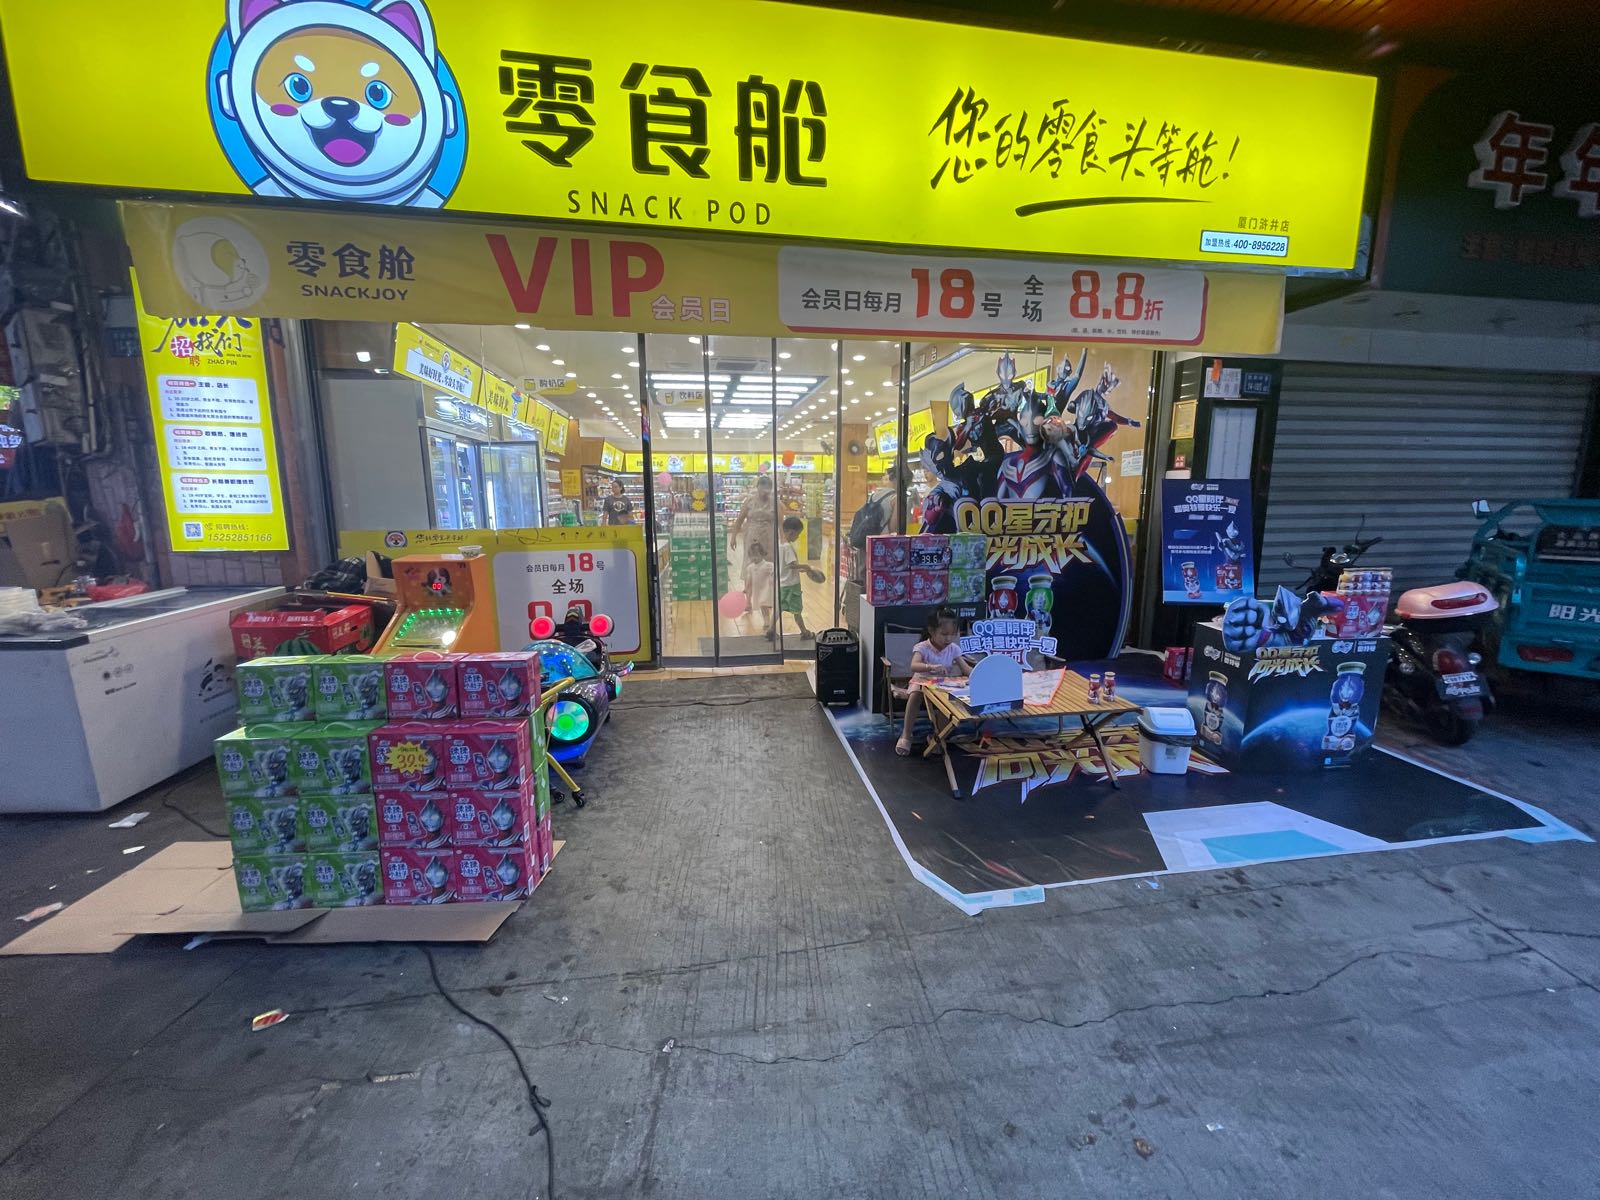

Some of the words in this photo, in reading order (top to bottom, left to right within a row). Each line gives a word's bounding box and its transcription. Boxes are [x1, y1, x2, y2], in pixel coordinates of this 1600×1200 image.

[498, 49, 828, 187] 零食舱
[929, 86, 1240, 189] 您的零食头等舱!
[567, 189, 682, 220] SNACK
[708, 200, 771, 225] POD
[286, 240, 416, 281] 零食舱
[485, 233, 665, 317] VIP
[301, 284, 409, 301] SNACKJOY
[651, 295, 731, 323] 会员日
[955, 497, 1095, 535] QQ星守护
[551, 578, 584, 595] 全场
